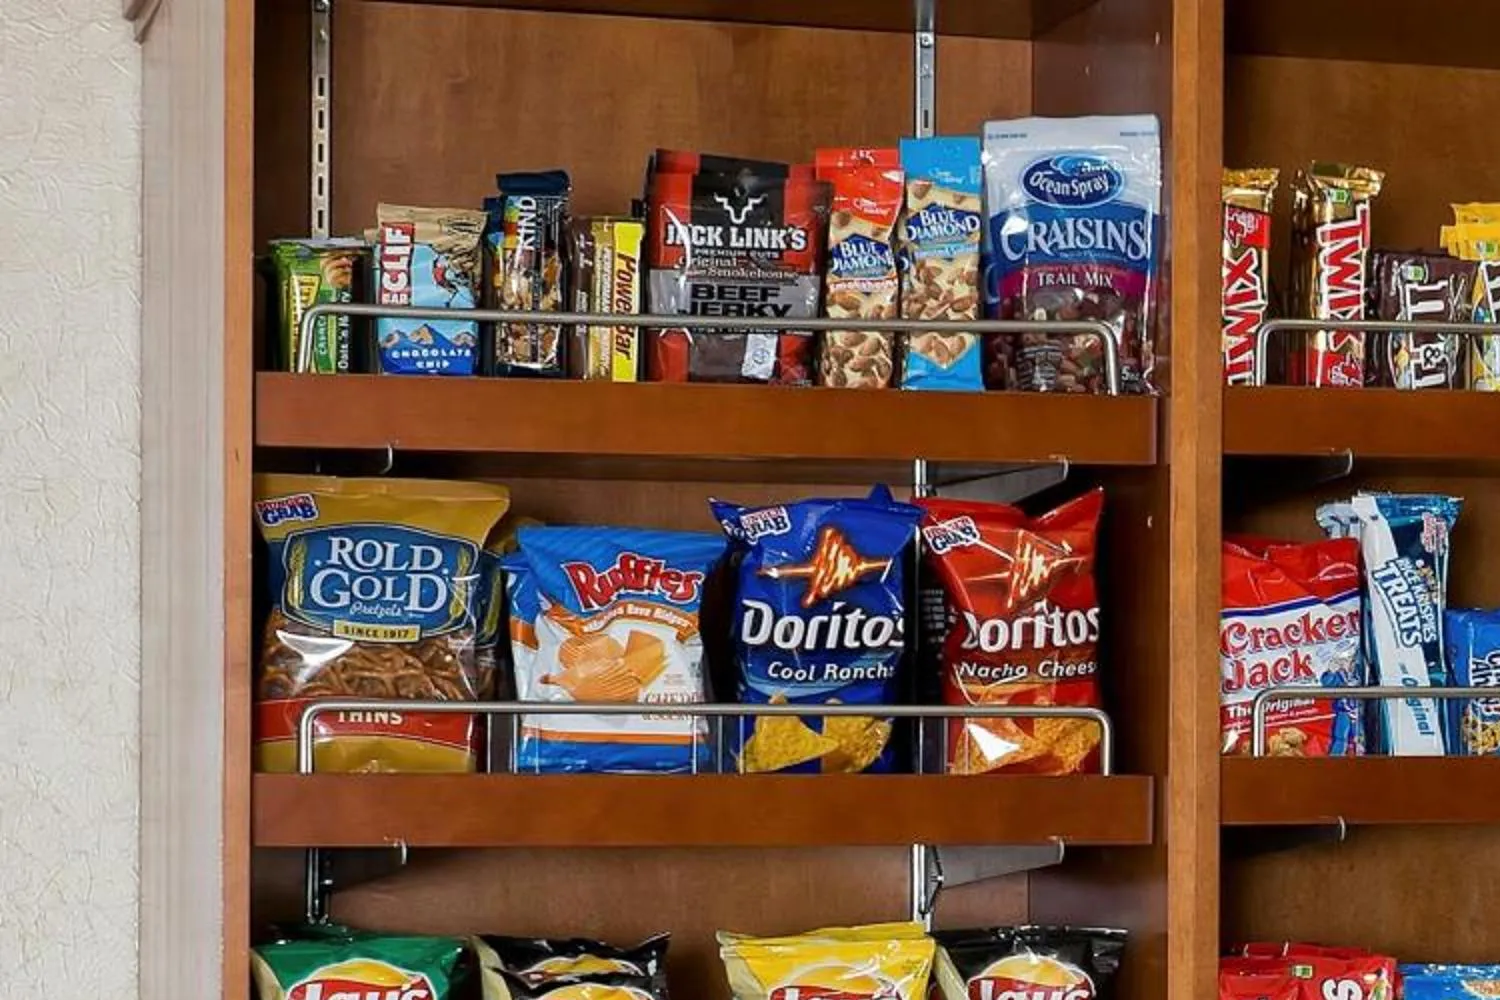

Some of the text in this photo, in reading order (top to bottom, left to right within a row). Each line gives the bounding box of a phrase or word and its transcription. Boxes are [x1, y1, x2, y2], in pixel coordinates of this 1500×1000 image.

[1030, 171, 1110, 197] Ocean Spray
[515, 197, 538, 251] KIND
[666, 223, 807, 250] JACK LINK'S
[1001, 216, 1146, 263] CRAISINS
[383, 226, 412, 293] CLIF
[1037, 271, 1078, 287] TRAIL
[1316, 203, 1371, 352] TWIX
[382, 292, 409, 305] BAR
[615, 253, 636, 360] PoweBar
[677, 302, 793, 318] JERKY
[692, 283, 781, 300] BEEF
[390, 347, 473, 361] CHOCOLATE
[415, 358, 451, 371] CHIP
[262, 504, 318, 525] GRAB
[326, 535, 444, 573] ROLD
[310, 567, 448, 613] GOLD
[562, 551, 704, 612] Ruffles
[741, 598, 905, 650] Doritos
[1372, 560, 1423, 649] TREATS
[1411, 581, 1437, 644] KRISPIES
[342, 625, 410, 639] SINCE 1917
[1219, 610, 1360, 658] Cracker
[768, 660, 891, 681] Cool Ranch
[960, 659, 1099, 680] Nacho Chees
[1221, 648, 1315, 694] Jack
[1402, 676, 1435, 736] Oginal
